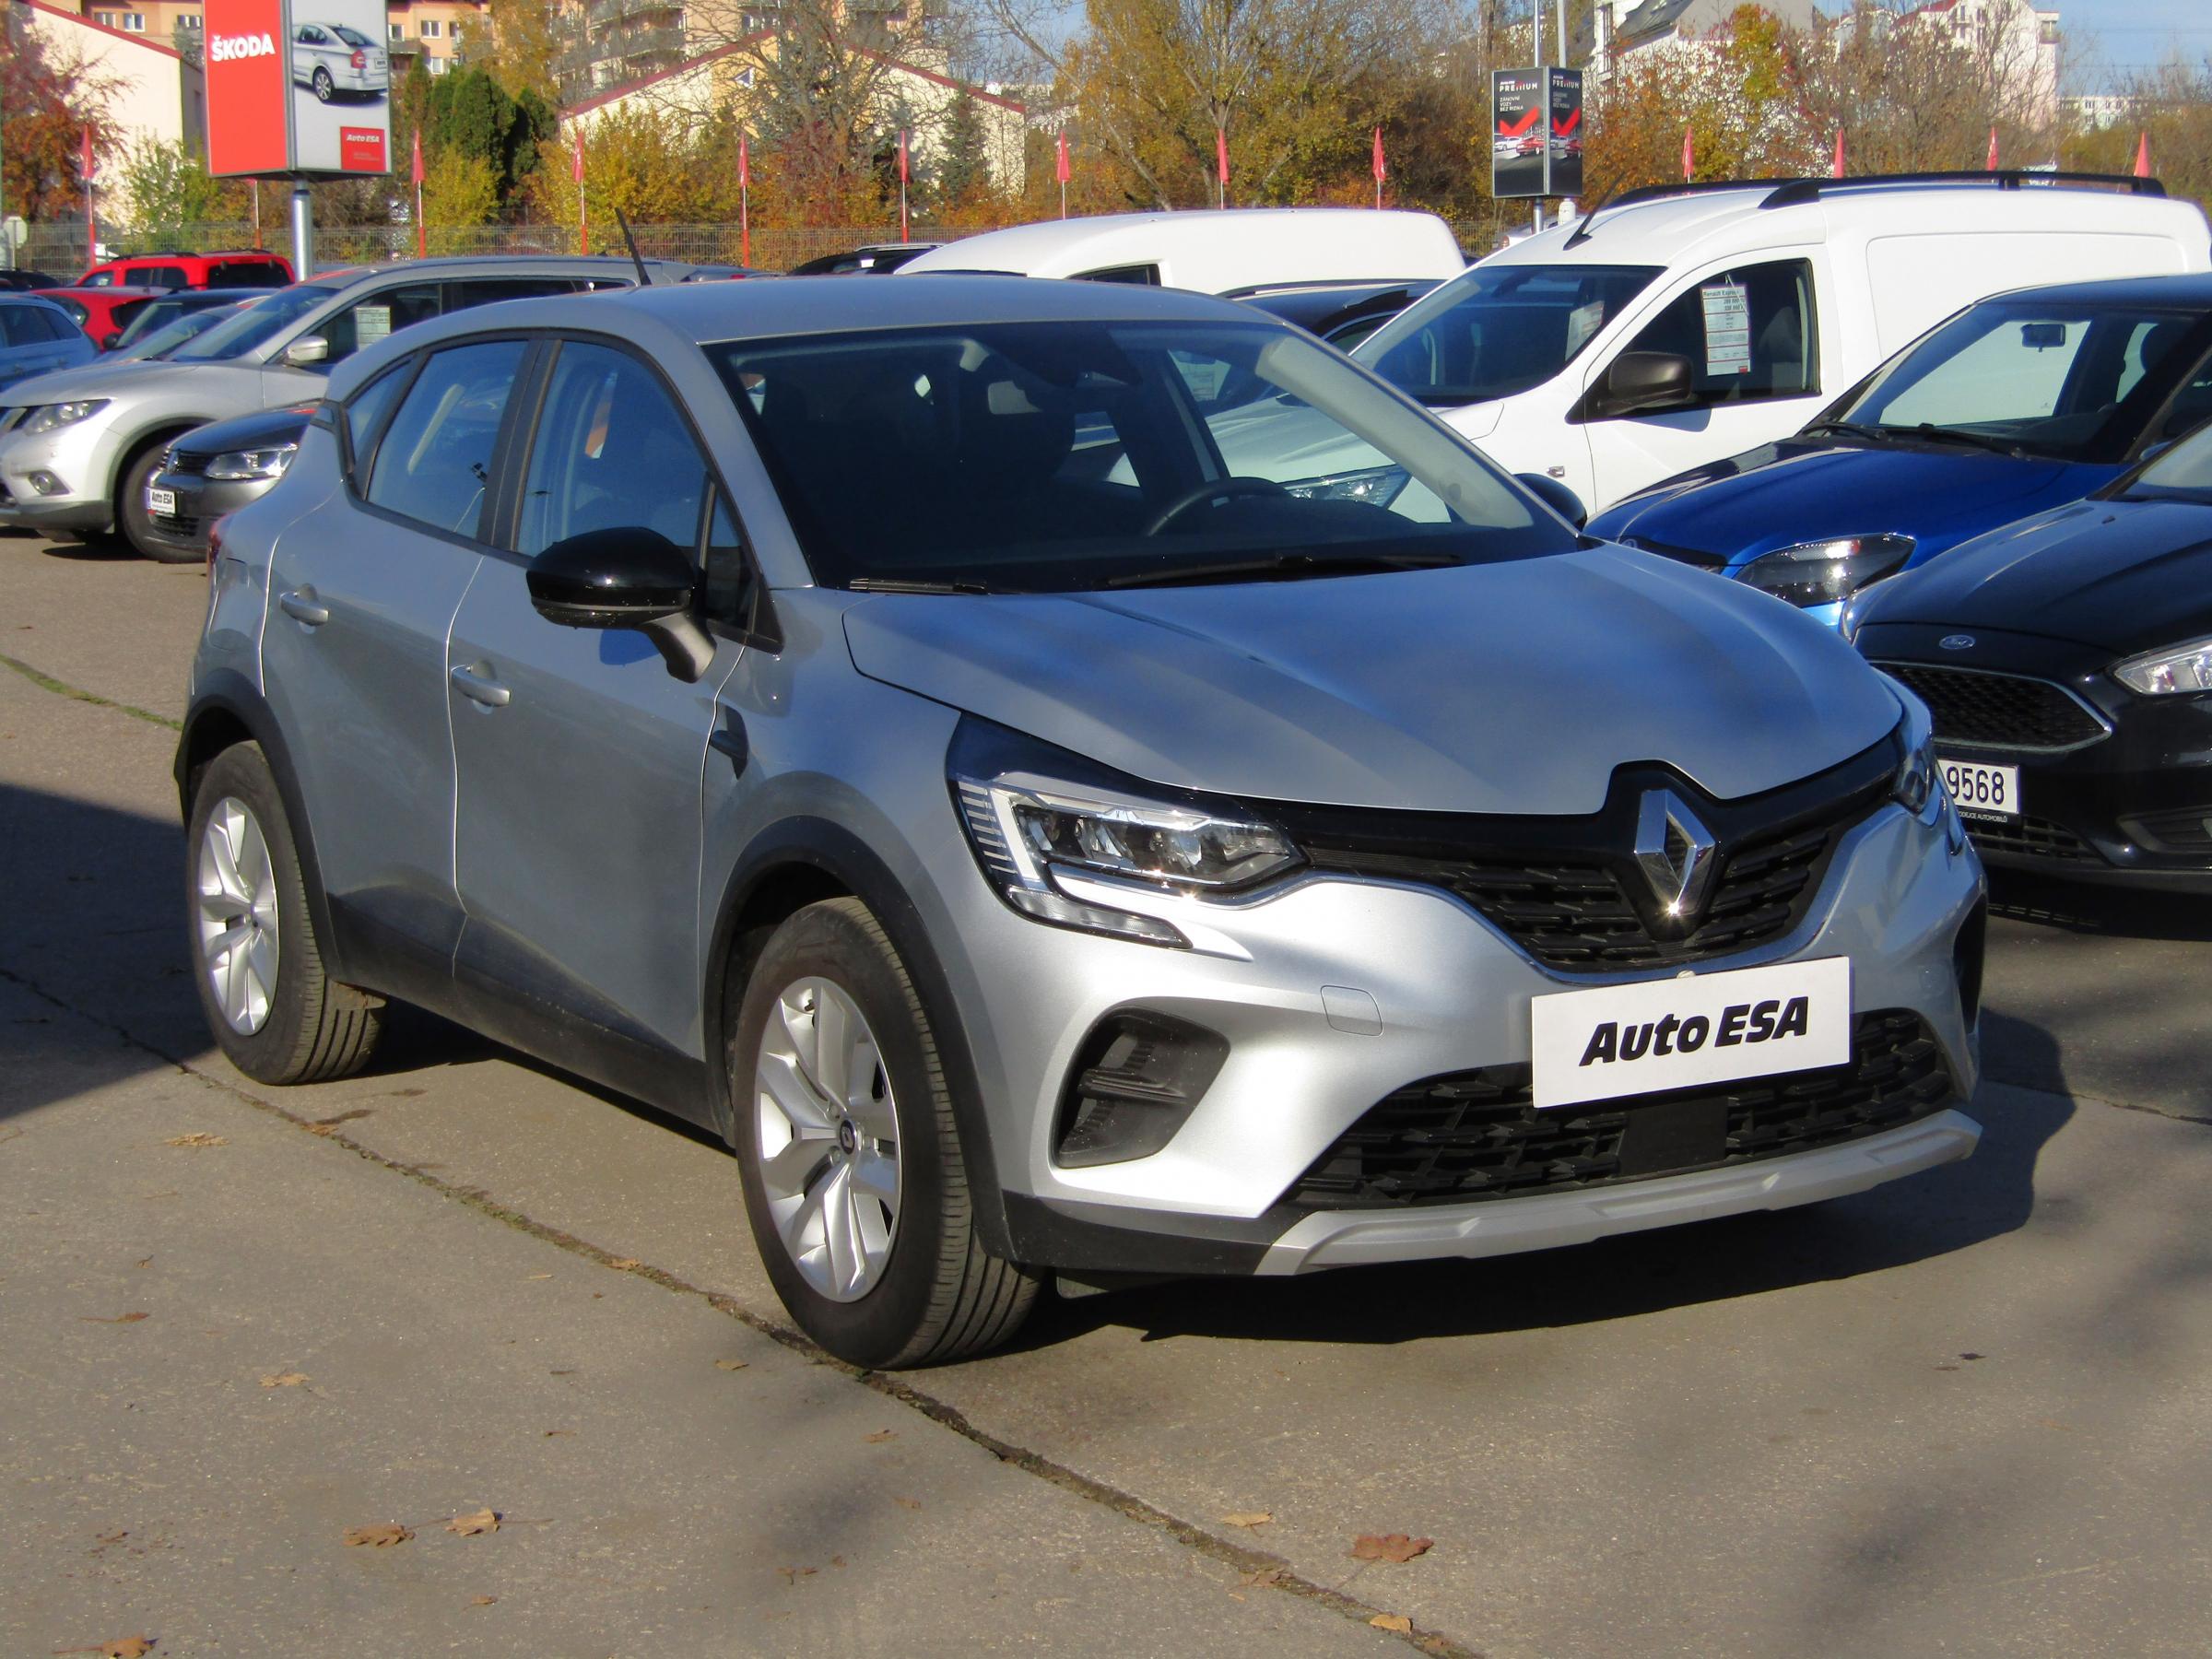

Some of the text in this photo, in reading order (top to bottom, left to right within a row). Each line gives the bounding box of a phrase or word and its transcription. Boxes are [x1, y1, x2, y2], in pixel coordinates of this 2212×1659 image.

[212, 33, 276, 62] ŠKODA
[1499, 81, 1538, 92] PREMIUM
[1552, 79, 1580, 89] PREMIUM
[347, 134, 365, 142] Auto
[152, 491, 173, 504] Auto ESA
[1946, 766, 2005, 805] 9568
[1579, 996, 1808, 1067] Auto ESA
